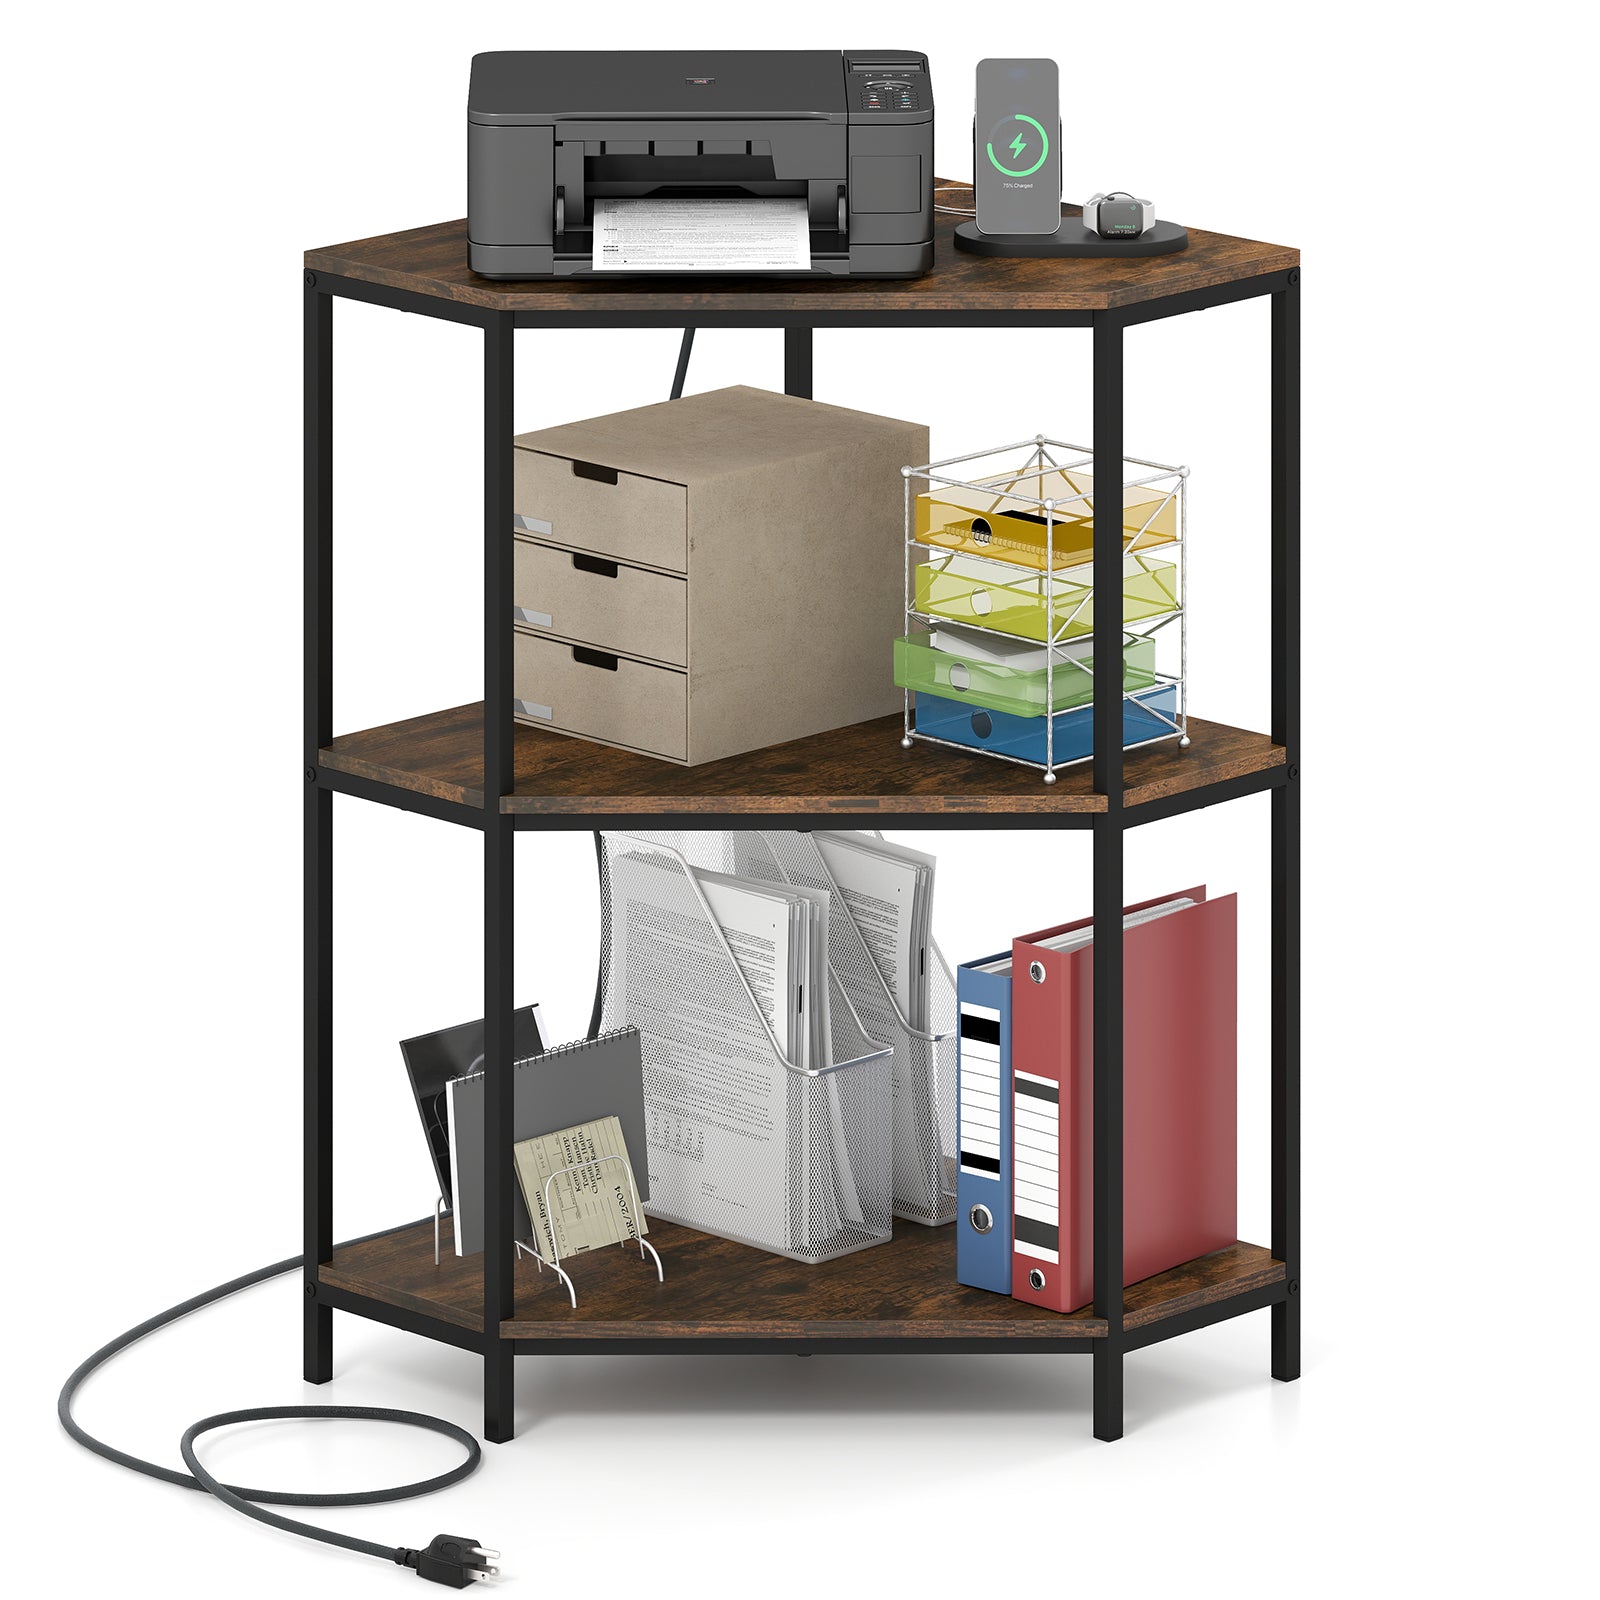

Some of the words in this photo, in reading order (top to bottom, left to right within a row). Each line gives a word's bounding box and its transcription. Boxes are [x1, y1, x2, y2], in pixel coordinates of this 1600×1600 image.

[562, 1136, 574, 1165] Knapp
[577, 1131, 588, 1155] Hahn
[585, 1138, 597, 1161] Radel
[571, 1166, 582, 1193] Kenn
[580, 1169, 589, 1189] Tom
[593, 1162, 602, 1181] Dan
[535, 1190, 547, 1219] Bryan
